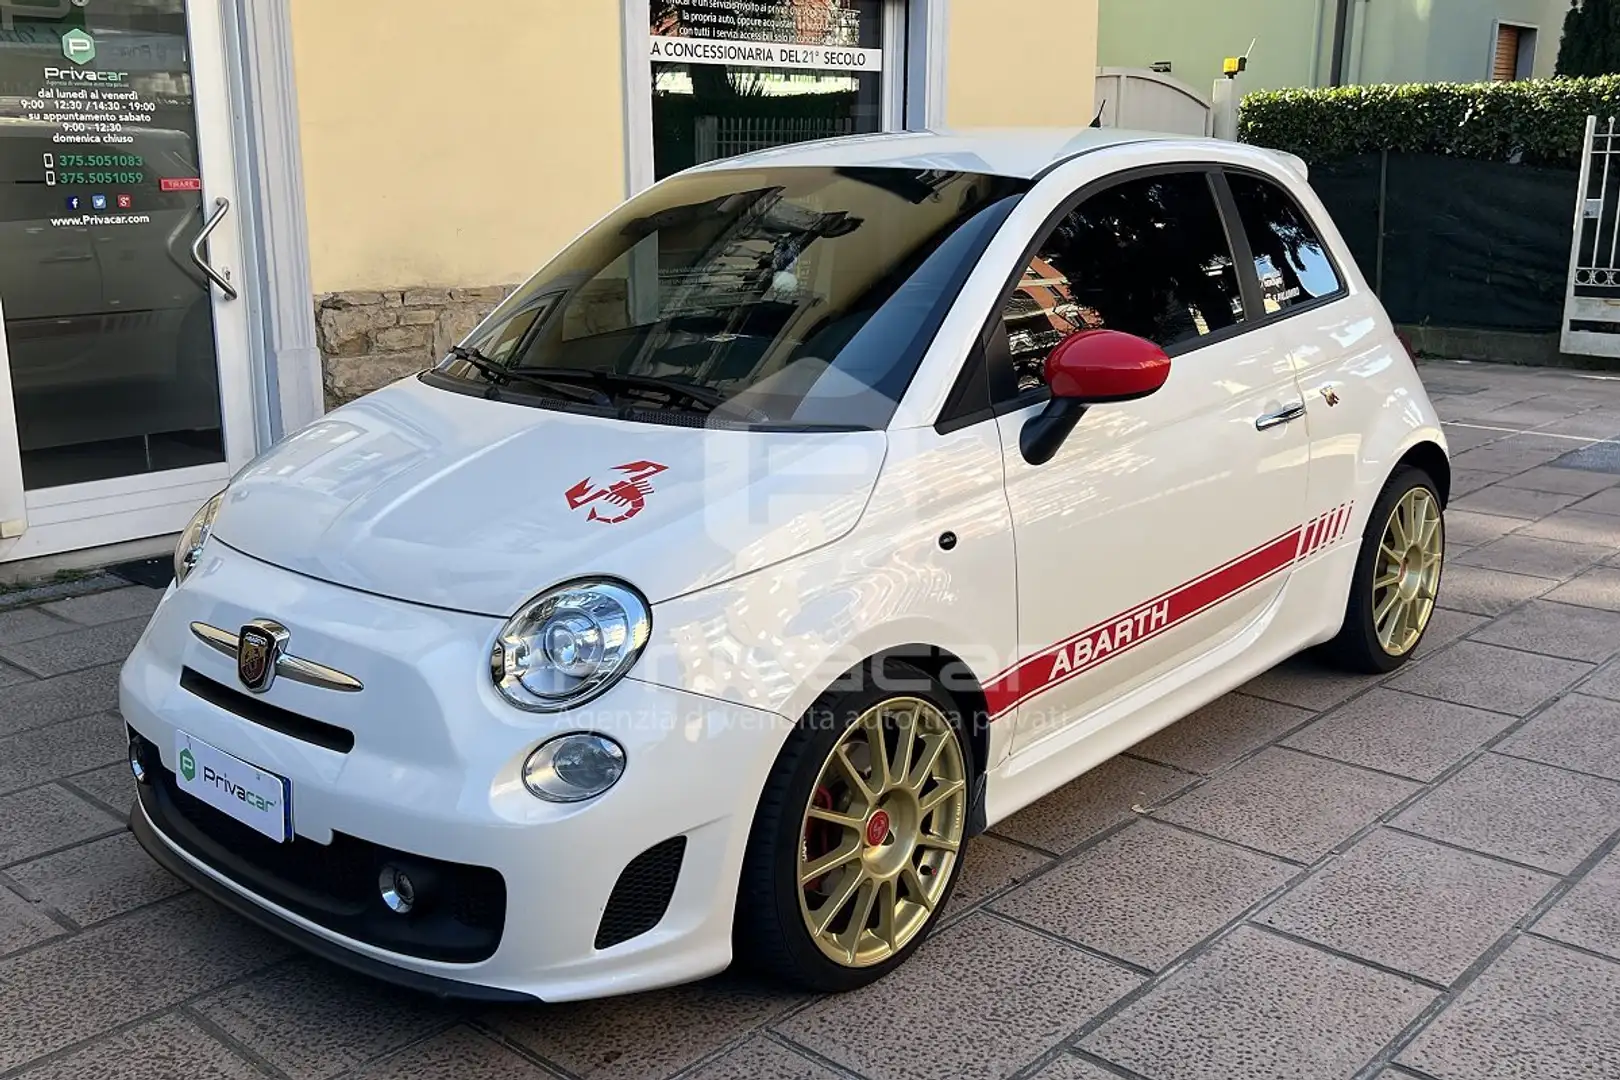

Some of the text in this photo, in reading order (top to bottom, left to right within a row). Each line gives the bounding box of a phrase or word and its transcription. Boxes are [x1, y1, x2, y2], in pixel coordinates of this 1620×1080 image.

[682, 10, 689, 20] la
[690, 12, 717, 24] propria
[718, 14, 735, 25] auto,
[679, 27, 693, 36] con
[694, 27, 710, 37] tutti
[665, 42, 774, 62] CONCESSIONARIA
[824, 52, 866, 66] SECOLO
[44, 66, 128, 82] Privacar
[38, 88, 138, 100] dal lunedì al venerdì
[20, 100, 44, 109] 9:00
[54, 101, 82, 110] 12:30
[128, 102, 155, 112] 19:00
[28, 111, 151, 122] su appuntamento sabato
[62, 122, 85, 132] 9:00
[95, 122, 121, 132] 12:30
[52, 133, 134, 143] domenica chiuso
[59, 155, 143, 167] 375.5051083
[60, 172, 143, 184] 375.5051059
[50, 215, 150, 226] www.Privacar.com
[1048, 600, 1169, 681] ABARTH
[203, 765, 276, 813] Privacar
